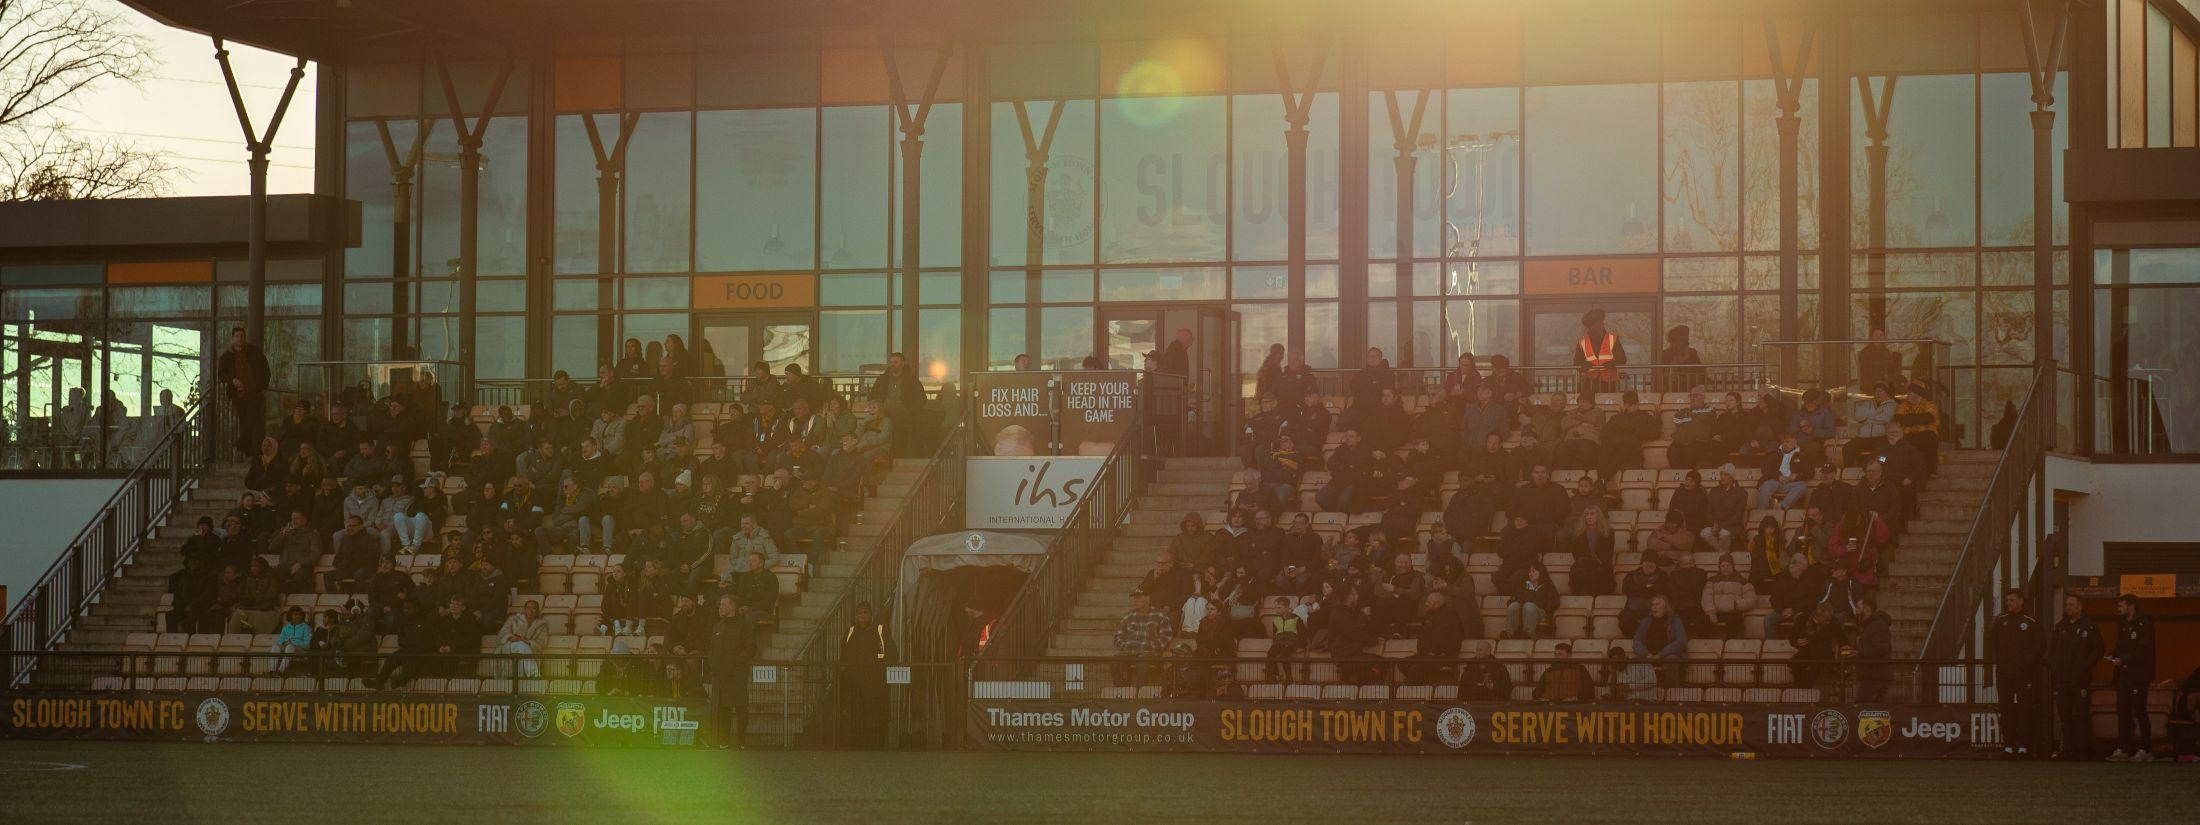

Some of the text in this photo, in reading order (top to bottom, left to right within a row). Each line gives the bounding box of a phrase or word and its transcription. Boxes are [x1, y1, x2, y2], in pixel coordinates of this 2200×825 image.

[1568, 266, 1612, 285] BAR
[725, 282, 784, 301] FOOD
[991, 387, 1039, 402] FIX HAIR
[1070, 382, 1129, 396] KEEP YOUR
[982, 403, 1048, 418] LOSS AND...
[1067, 395, 1132, 409] HEAD IN THE
[1084, 409, 1114, 423] GAME
[1014, 461, 1084, 508] ihs
[988, 516, 1056, 525] INTERNATIONAL
[12, 698, 92, 729] SLOUGH
[96, 698, 155, 730] TOWN
[158, 699, 186, 732] FC
[242, 700, 308, 733] SERVE
[311, 702, 368, 733] WITH
[371, 703, 459, 734] HONOUR
[478, 704, 510, 733] FIAT
[594, 708, 644, 733] Jeep
[985, 707, 1195, 728] Thames Motor Group
[1219, 707, 1313, 742] SLOUGH
[1320, 708, 1387, 743] TOWN
[1391, 709, 1423, 743] FC
[984, 727, 1195, 744] www.thamesmotorgroup.co.uk
[1490, 710, 1570, 745] SERVE
[1575, 710, 1638, 744] WITH
[1643, 711, 1744, 745] HONOUR
[1766, 713, 1806, 743] FIAT
[1901, 716, 1961, 742] Jeep
[1970, 712, 2003, 743] FIA
